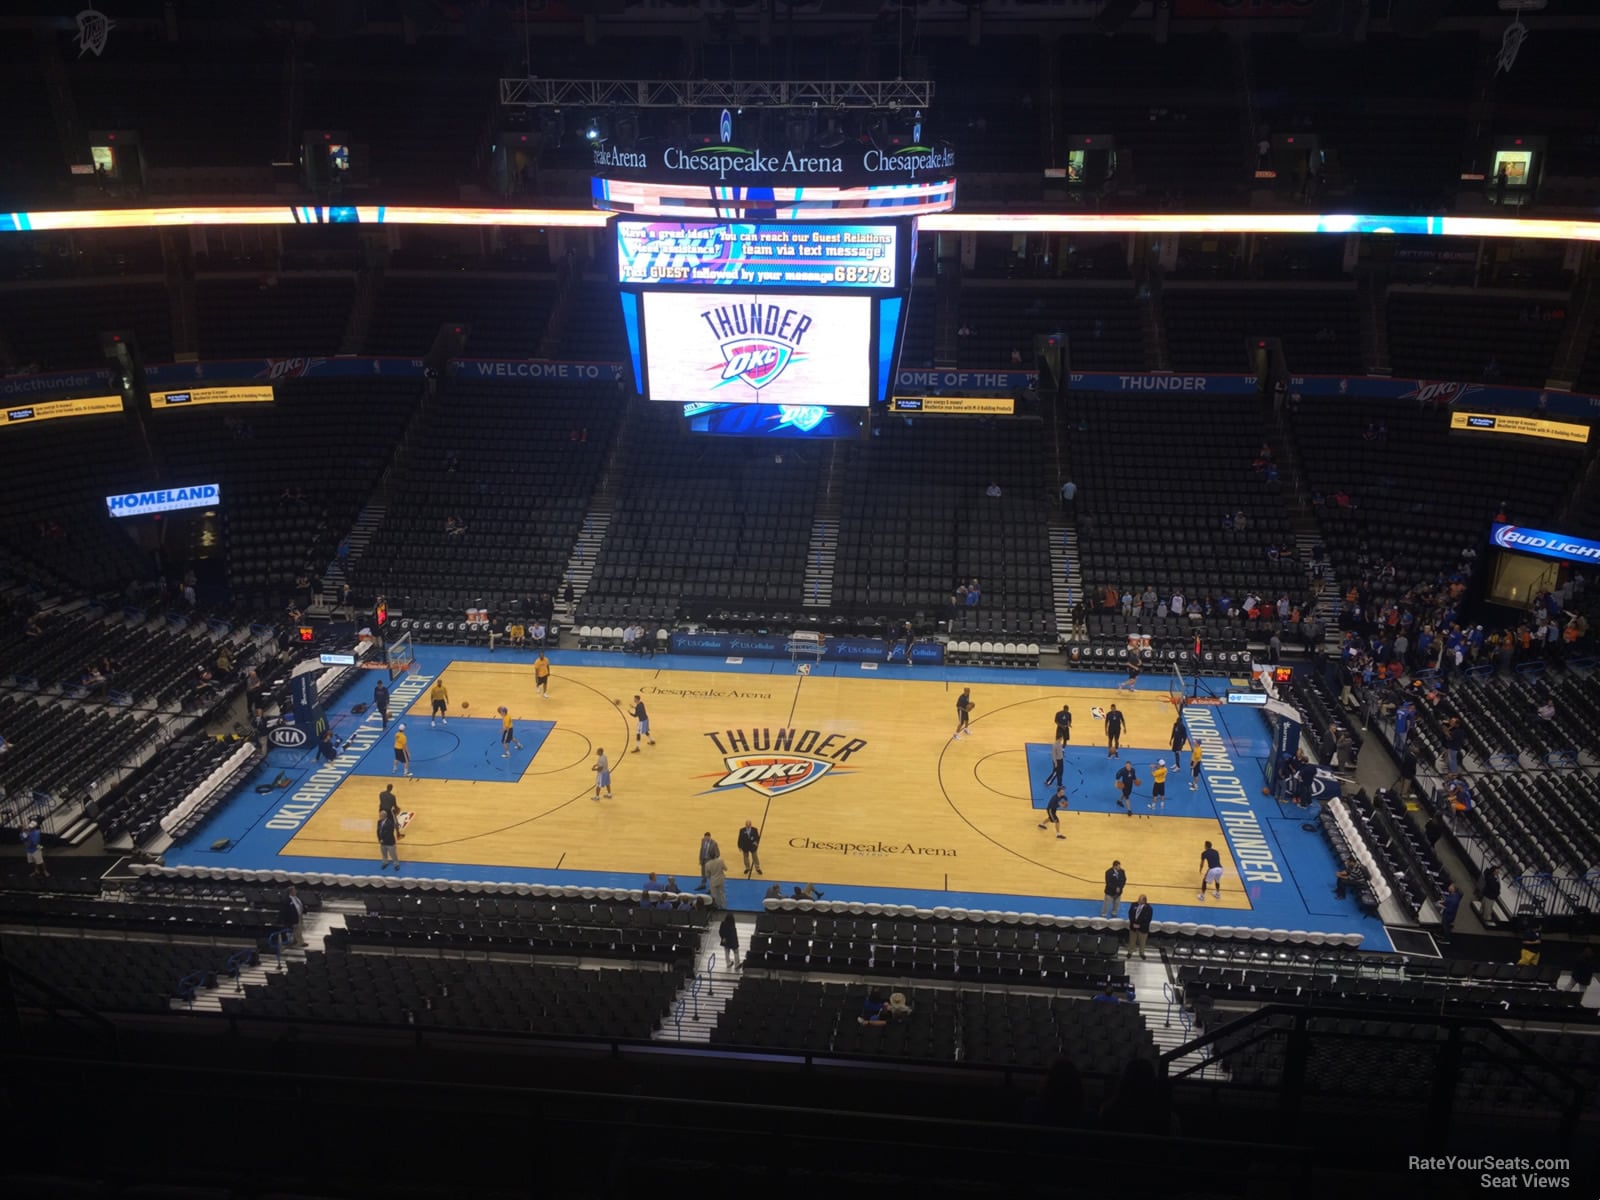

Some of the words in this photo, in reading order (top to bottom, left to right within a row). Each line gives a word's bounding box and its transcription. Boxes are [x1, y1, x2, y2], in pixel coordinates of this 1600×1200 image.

[611, 146, 647, 168] Arena
[664, 147, 780, 180] Chesapeake
[782, 150, 843, 173] Arena
[863, 147, 941, 178] Chesapeake
[720, 230, 737, 241] You
[741, 233, 757, 242] can
[761, 231, 789, 242] reach
[792, 234, 809, 242] our
[812, 232, 840, 243] Guest
[843, 232, 892, 244] Relations
[742, 244, 773, 256] team
[777, 244, 795, 256] via
[799, 245, 822, 257] text
[826, 246, 885, 260] message!
[650, 266, 690, 279] GUEST
[741, 268, 755, 281] by
[834, 266, 892, 284] 68278
[701, 303, 812, 345] THUNDER
[477, 362, 568, 377] WELCOME
[575, 365, 599, 378] TO
[722, 348, 778, 379] OKC
[944, 372, 968, 386] OF
[975, 374, 1008, 387] THE
[1119, 376, 1206, 391] THUNDER
[1416, 382, 1457, 401] OKC
[110, 486, 216, 509] HOMELAND
[1503, 531, 1547, 547] BUD
[639, 686, 725, 698] Chesapeake
[728, 689, 772, 699] Arena
[275, 731, 301, 743] KIA
[704, 728, 867, 762] THUNDER
[713, 762, 809, 787] OKC
[1207, 775, 1250, 806] CITY
[789, 837, 899, 856] Chesapeake
[901, 843, 957, 857] Arena
[1221, 810, 1283, 883] THUNDER
